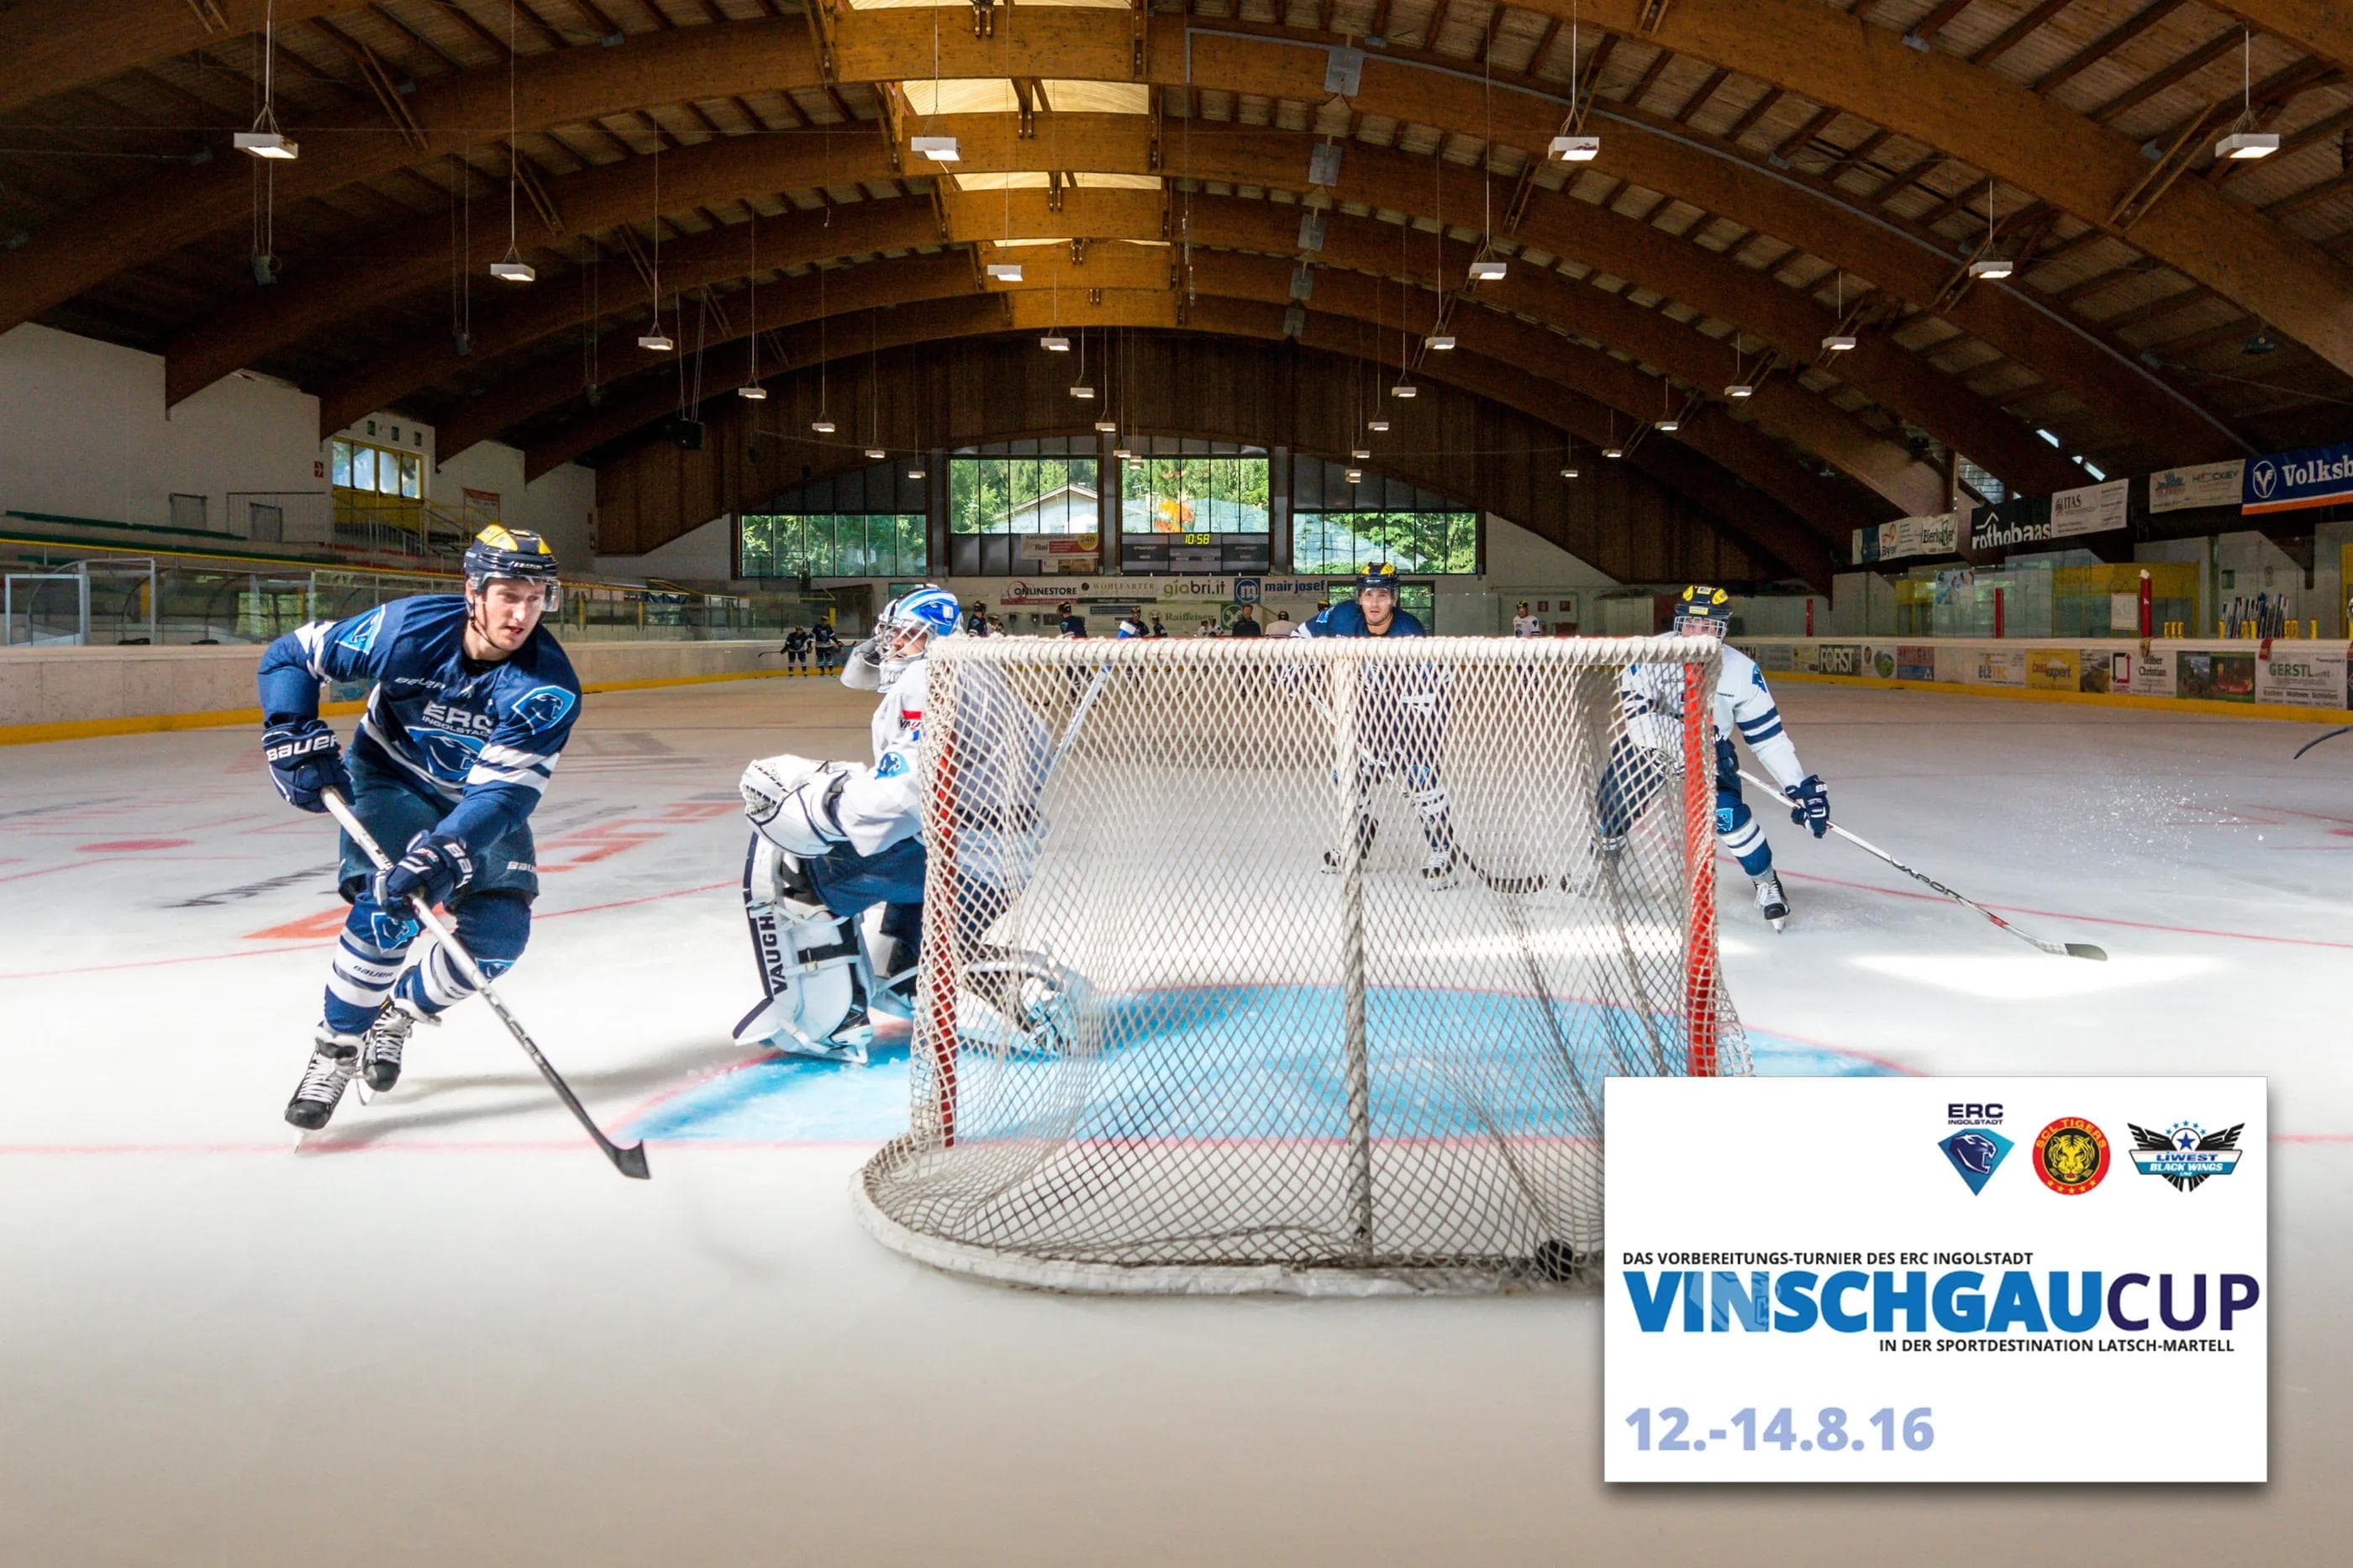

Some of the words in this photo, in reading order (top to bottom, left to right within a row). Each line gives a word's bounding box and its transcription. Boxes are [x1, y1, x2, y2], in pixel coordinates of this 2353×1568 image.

[1185, 534, 1210, 545] 10:58
[1265, 581, 1293, 592] mair
[1295, 580, 1325, 593] josef
[1820, 647, 1855, 672] FORST
[423, 700, 492, 731] ERC
[757, 911, 788, 996] VAUGH
